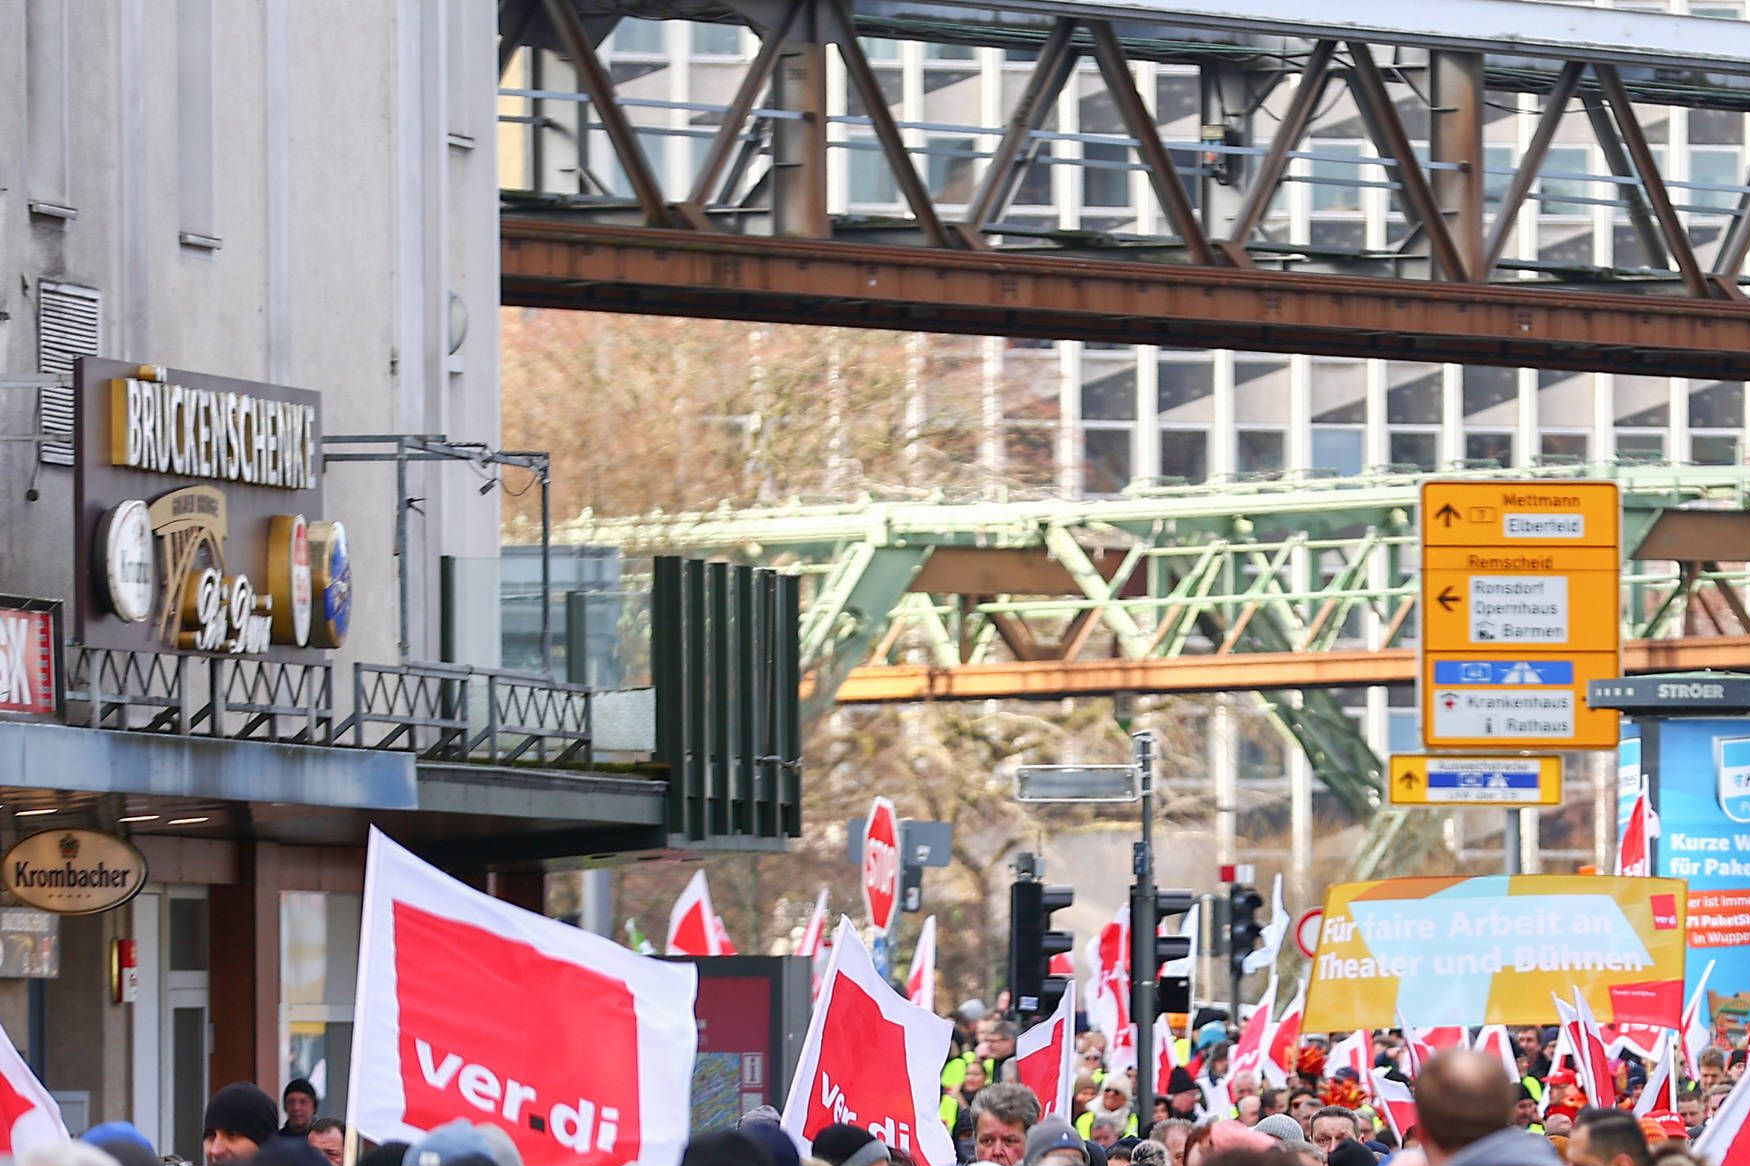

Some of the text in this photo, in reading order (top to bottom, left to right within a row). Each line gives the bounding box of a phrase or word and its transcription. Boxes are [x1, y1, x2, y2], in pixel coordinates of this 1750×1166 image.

[1503, 494, 1581, 507] Mettmann
[1509, 518, 1581, 533] Elberfeld
[1468, 554, 1554, 569] Remscheid
[1474, 579, 1545, 594] Ronsdorf
[1475, 601, 1559, 617] Opernhaus
[1503, 623, 1564, 638] Barmen
[1657, 682, 1724, 699] STRÖER
[1467, 696, 1570, 709] Krankenhaus
[1506, 717, 1570, 732] Rathaus
[1671, 834, 1730, 851] Kurze
[867, 837, 895, 895] STOP
[1669, 858, 1700, 877] für
[15, 859, 131, 889] Krombacher
[1703, 897, 1720, 908] ist
[1322, 906, 1613, 945] Für faire Arbeit an
[1693, 933, 1706, 944] in
[1318, 941, 1644, 981] Theater und Bühnen
[415, 1037, 620, 1154] ver.di
